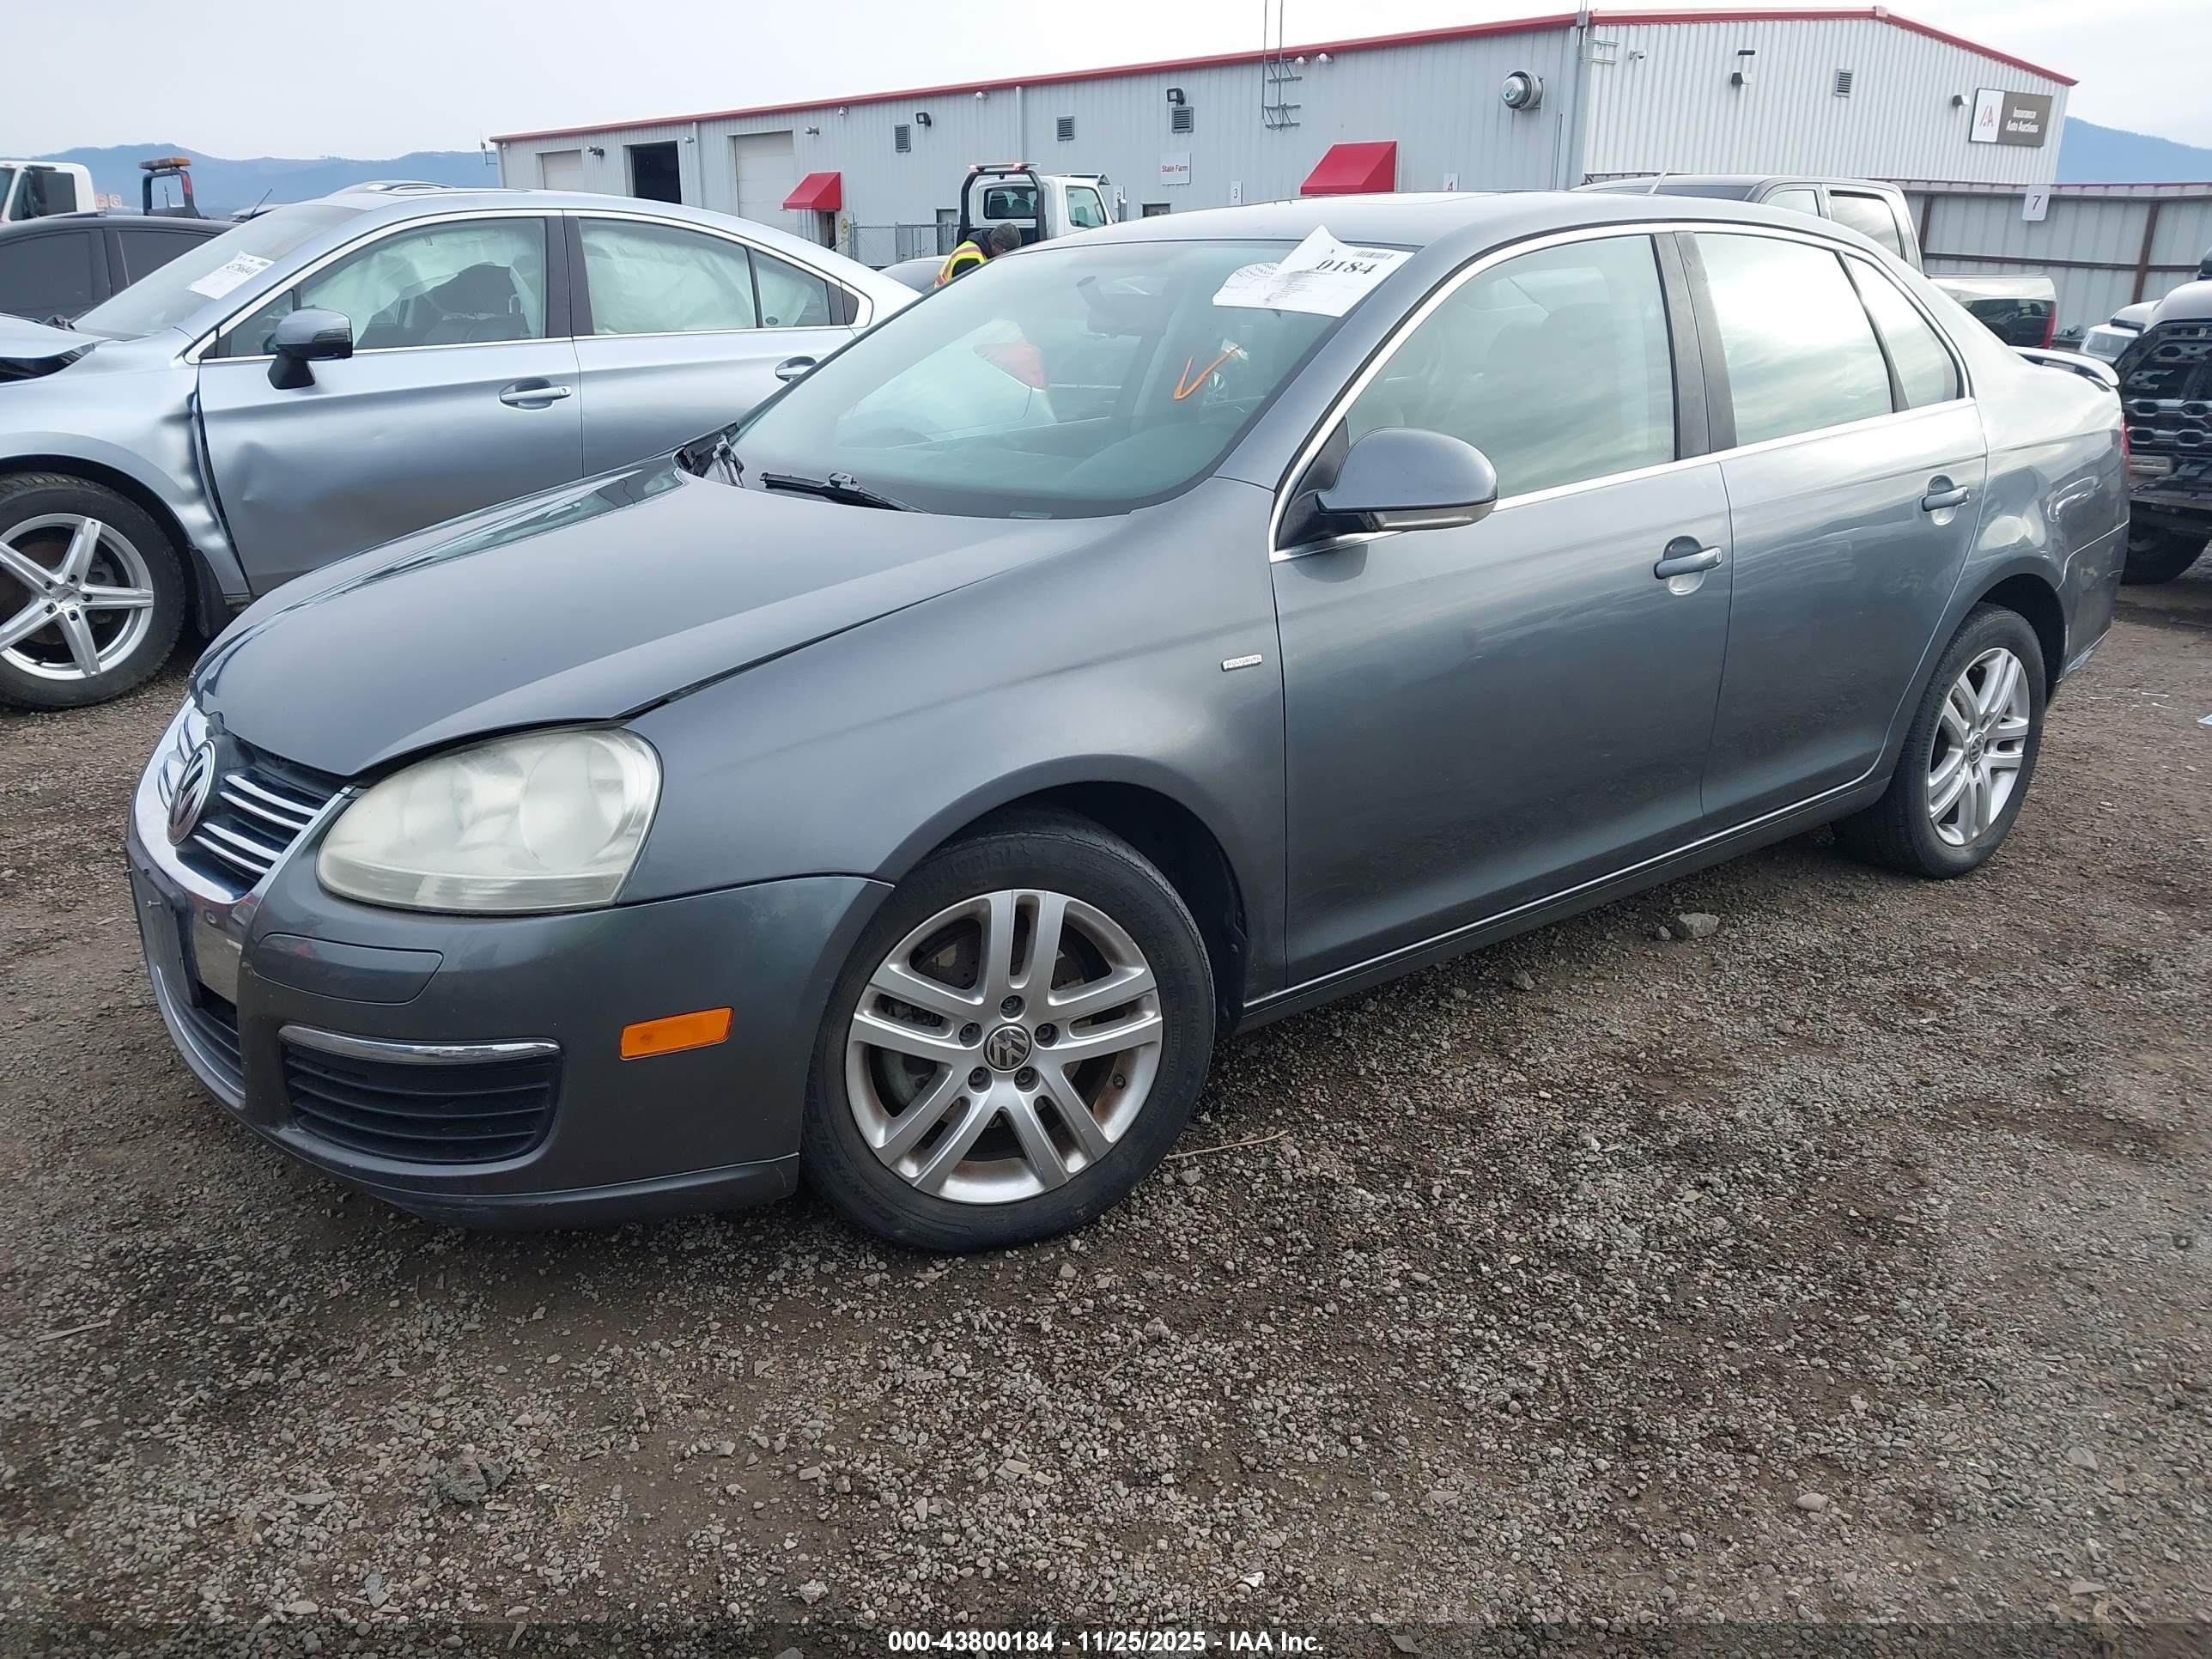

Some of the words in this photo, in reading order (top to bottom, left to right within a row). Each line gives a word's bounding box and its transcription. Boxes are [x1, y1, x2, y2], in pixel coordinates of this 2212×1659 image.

[1175, 164, 1189, 173] Farm
[1233, 188, 1238, 199] 3
[2033, 194, 2042, 210] 7
[1316, 258, 1377, 275] 0184
